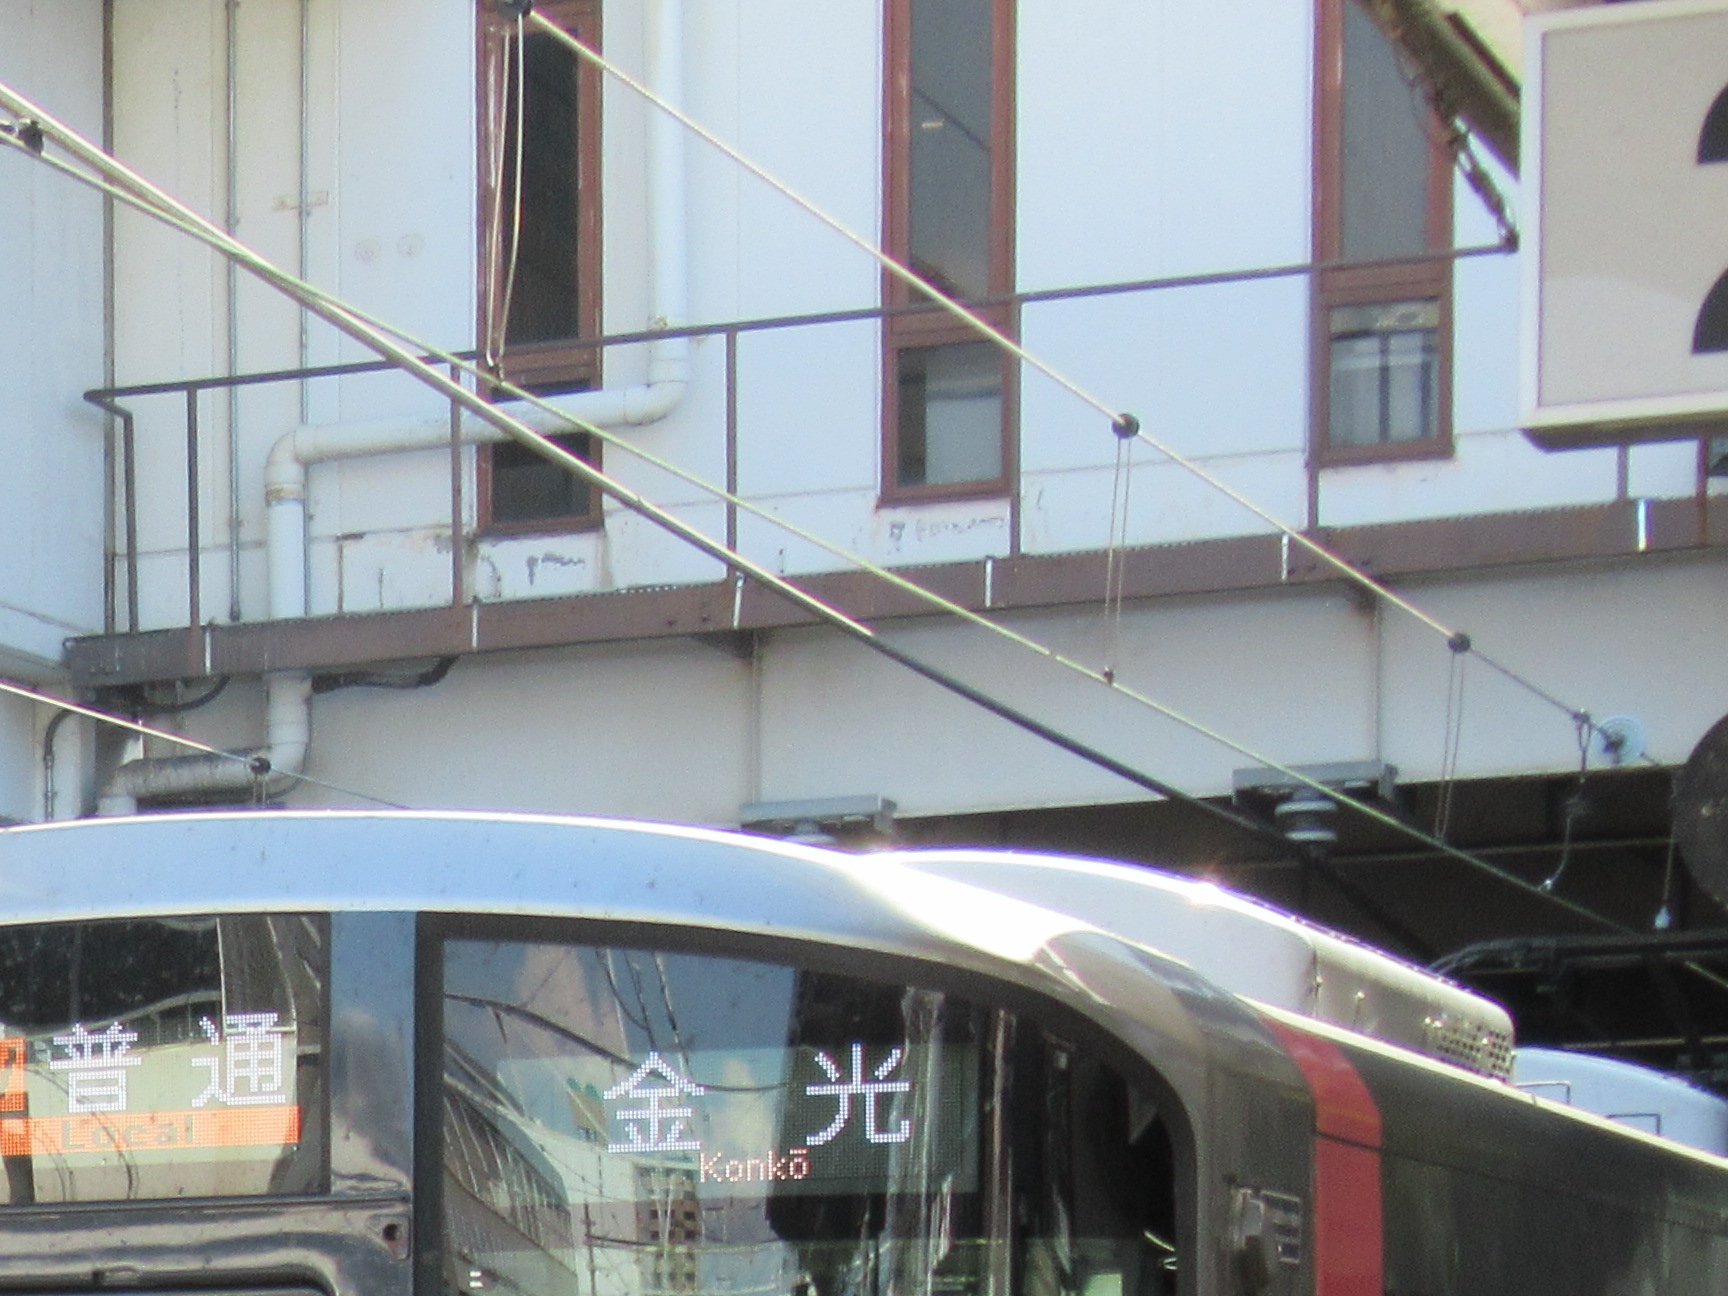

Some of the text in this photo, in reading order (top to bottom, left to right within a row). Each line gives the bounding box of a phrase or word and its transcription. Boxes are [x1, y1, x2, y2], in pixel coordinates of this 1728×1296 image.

[49, 1012, 287, 1114] 普通
[603, 1042, 912, 1152] 金光
[62, 1115, 194, 1151] Local
